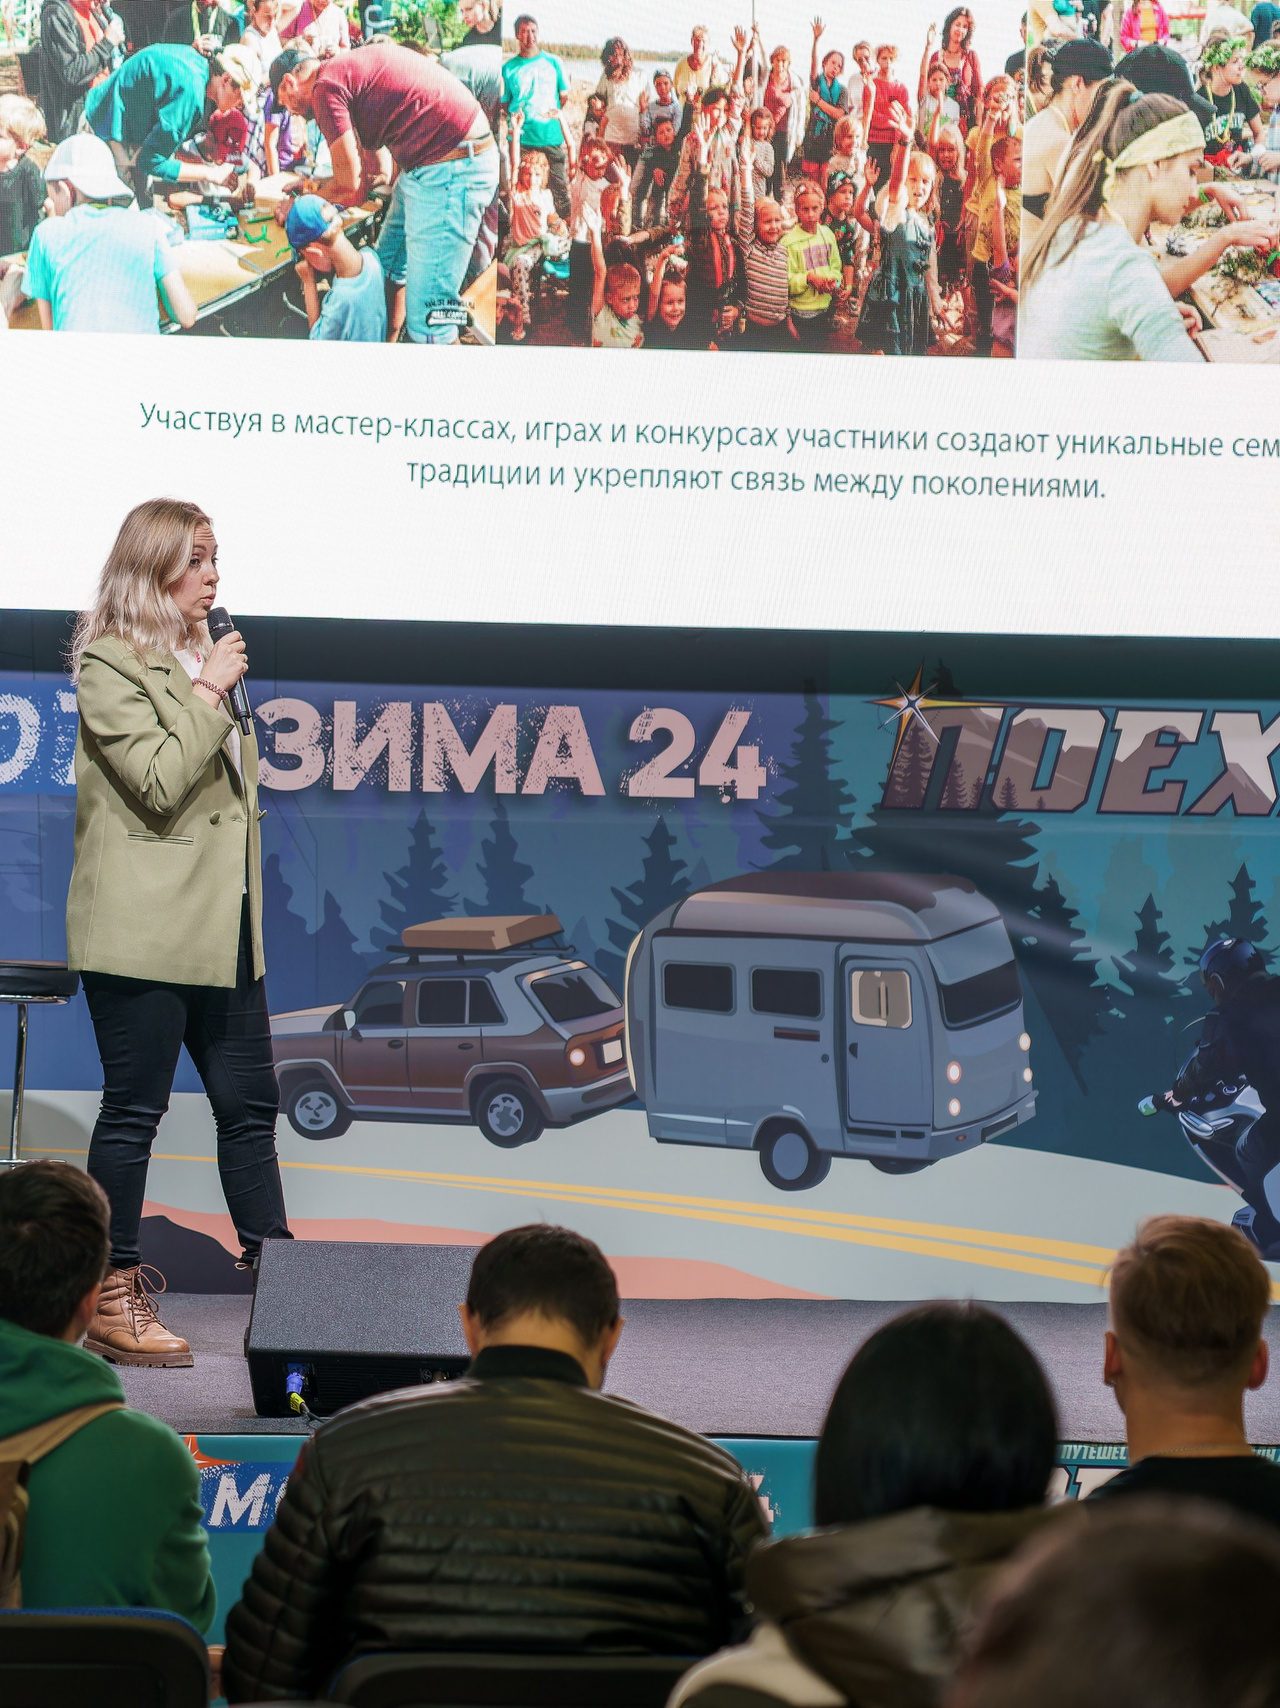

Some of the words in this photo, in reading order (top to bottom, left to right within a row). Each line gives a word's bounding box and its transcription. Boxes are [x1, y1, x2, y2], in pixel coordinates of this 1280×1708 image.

[140, 402, 262, 438] Участвуя
[272, 414, 286, 433] в
[295, 415, 516, 443] мастер-классах,
[525, 420, 602, 449] играх
[611, 423, 626, 443] и
[635, 424, 778, 453] конкурсах
[786, 428, 928, 454] участники
[936, 431, 1048, 456] создают
[1056, 433, 1223, 461] уникальные
[1232, 437, 1280, 458] сем
[406, 461, 540, 490] традиции
[550, 466, 565, 486] и
[573, 466, 723, 494] укрепляют
[730, 470, 805, 492] связь
[814, 473, 903, 500] между
[912, 474, 1106, 499] поколениями.
[622, 706, 770, 803] 24
[880, 704, 1280, 817] ПОЕХ
[1060, 1444, 1128, 1460] ПУТЕШЕС
